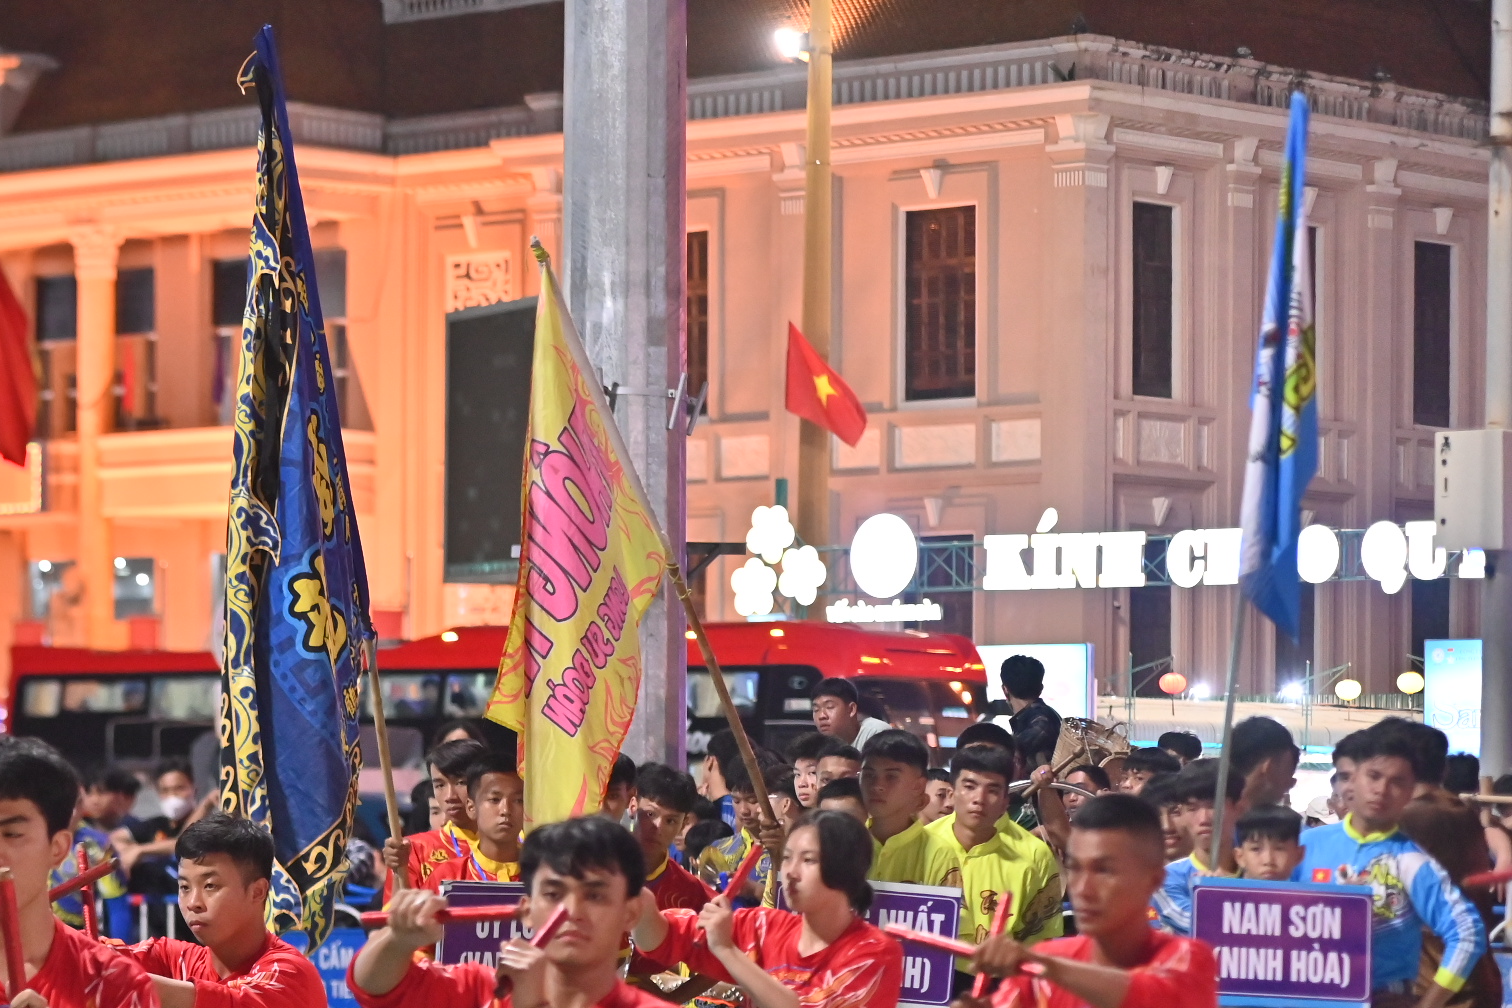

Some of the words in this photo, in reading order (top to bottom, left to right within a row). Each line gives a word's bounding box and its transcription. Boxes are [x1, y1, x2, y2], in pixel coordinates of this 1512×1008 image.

[982, 507, 1146, 591] KÍNH
[1166, 523, 1340, 588] CHO
[1222, 902, 1282, 936] NAM
[1288, 903, 1342, 939] SƠN
[1290, 943, 1351, 988] HÒA)
